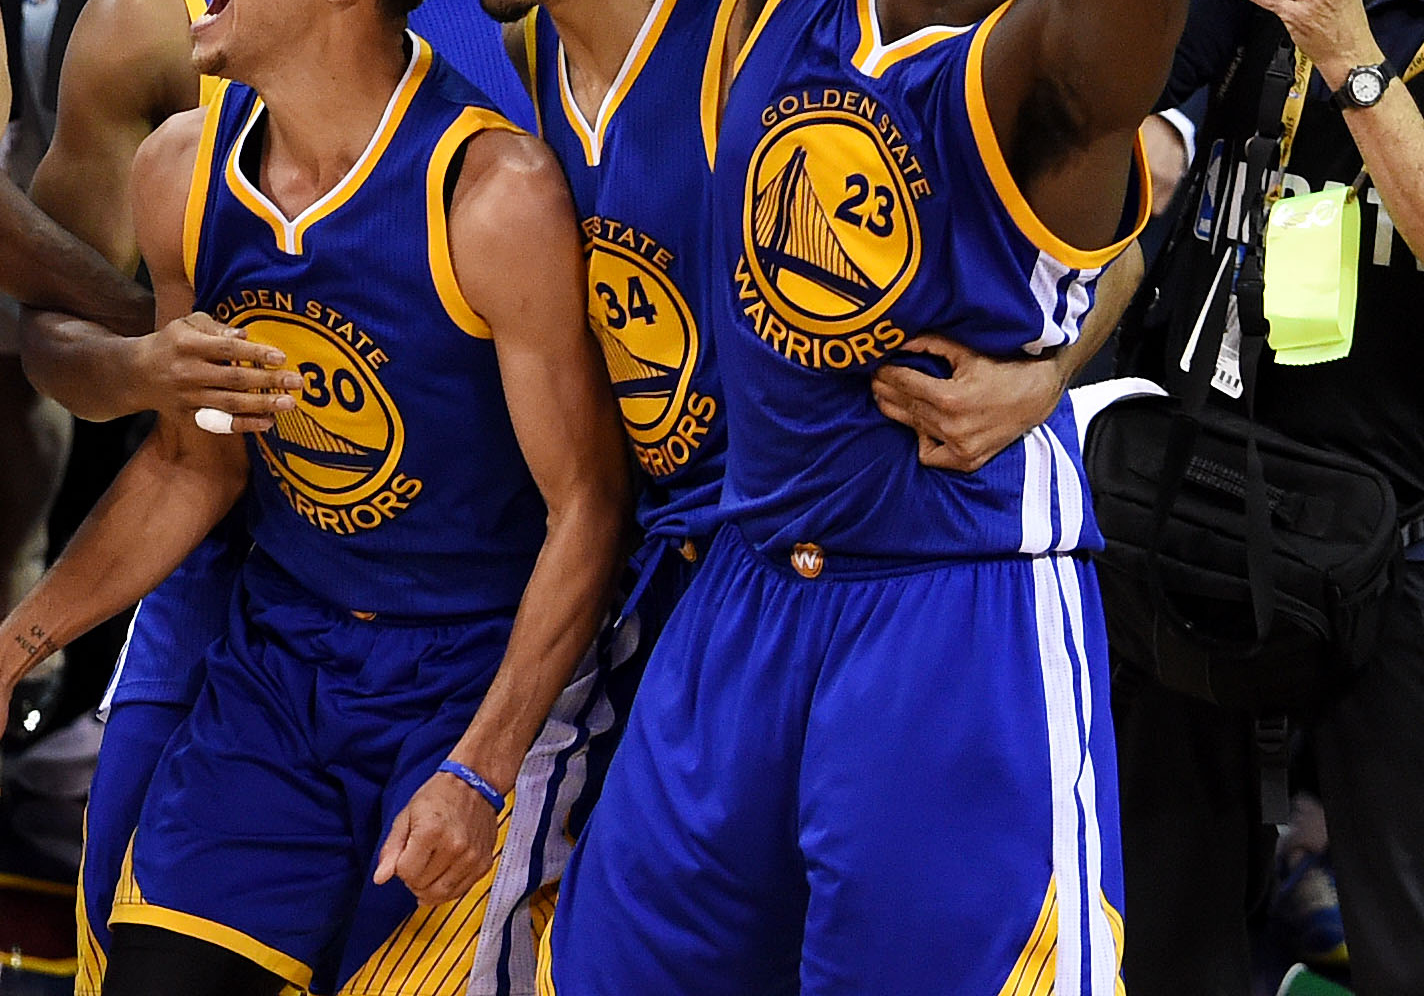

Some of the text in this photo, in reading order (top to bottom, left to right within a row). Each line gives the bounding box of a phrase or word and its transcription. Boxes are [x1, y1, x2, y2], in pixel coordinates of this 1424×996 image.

[761, 89, 933, 200] GOLDEN STATE
[834, 174, 896, 237] 23
[592, 216, 675, 270] STATE
[213, 289, 391, 371] OLDEN STATE
[595, 276, 657, 331] 34
[734, 253, 906, 369] WARRIORS
[298, 362, 365, 413] 30
[634, 391, 717, 477] RRIORS
[794, 550, 820, 570] W
